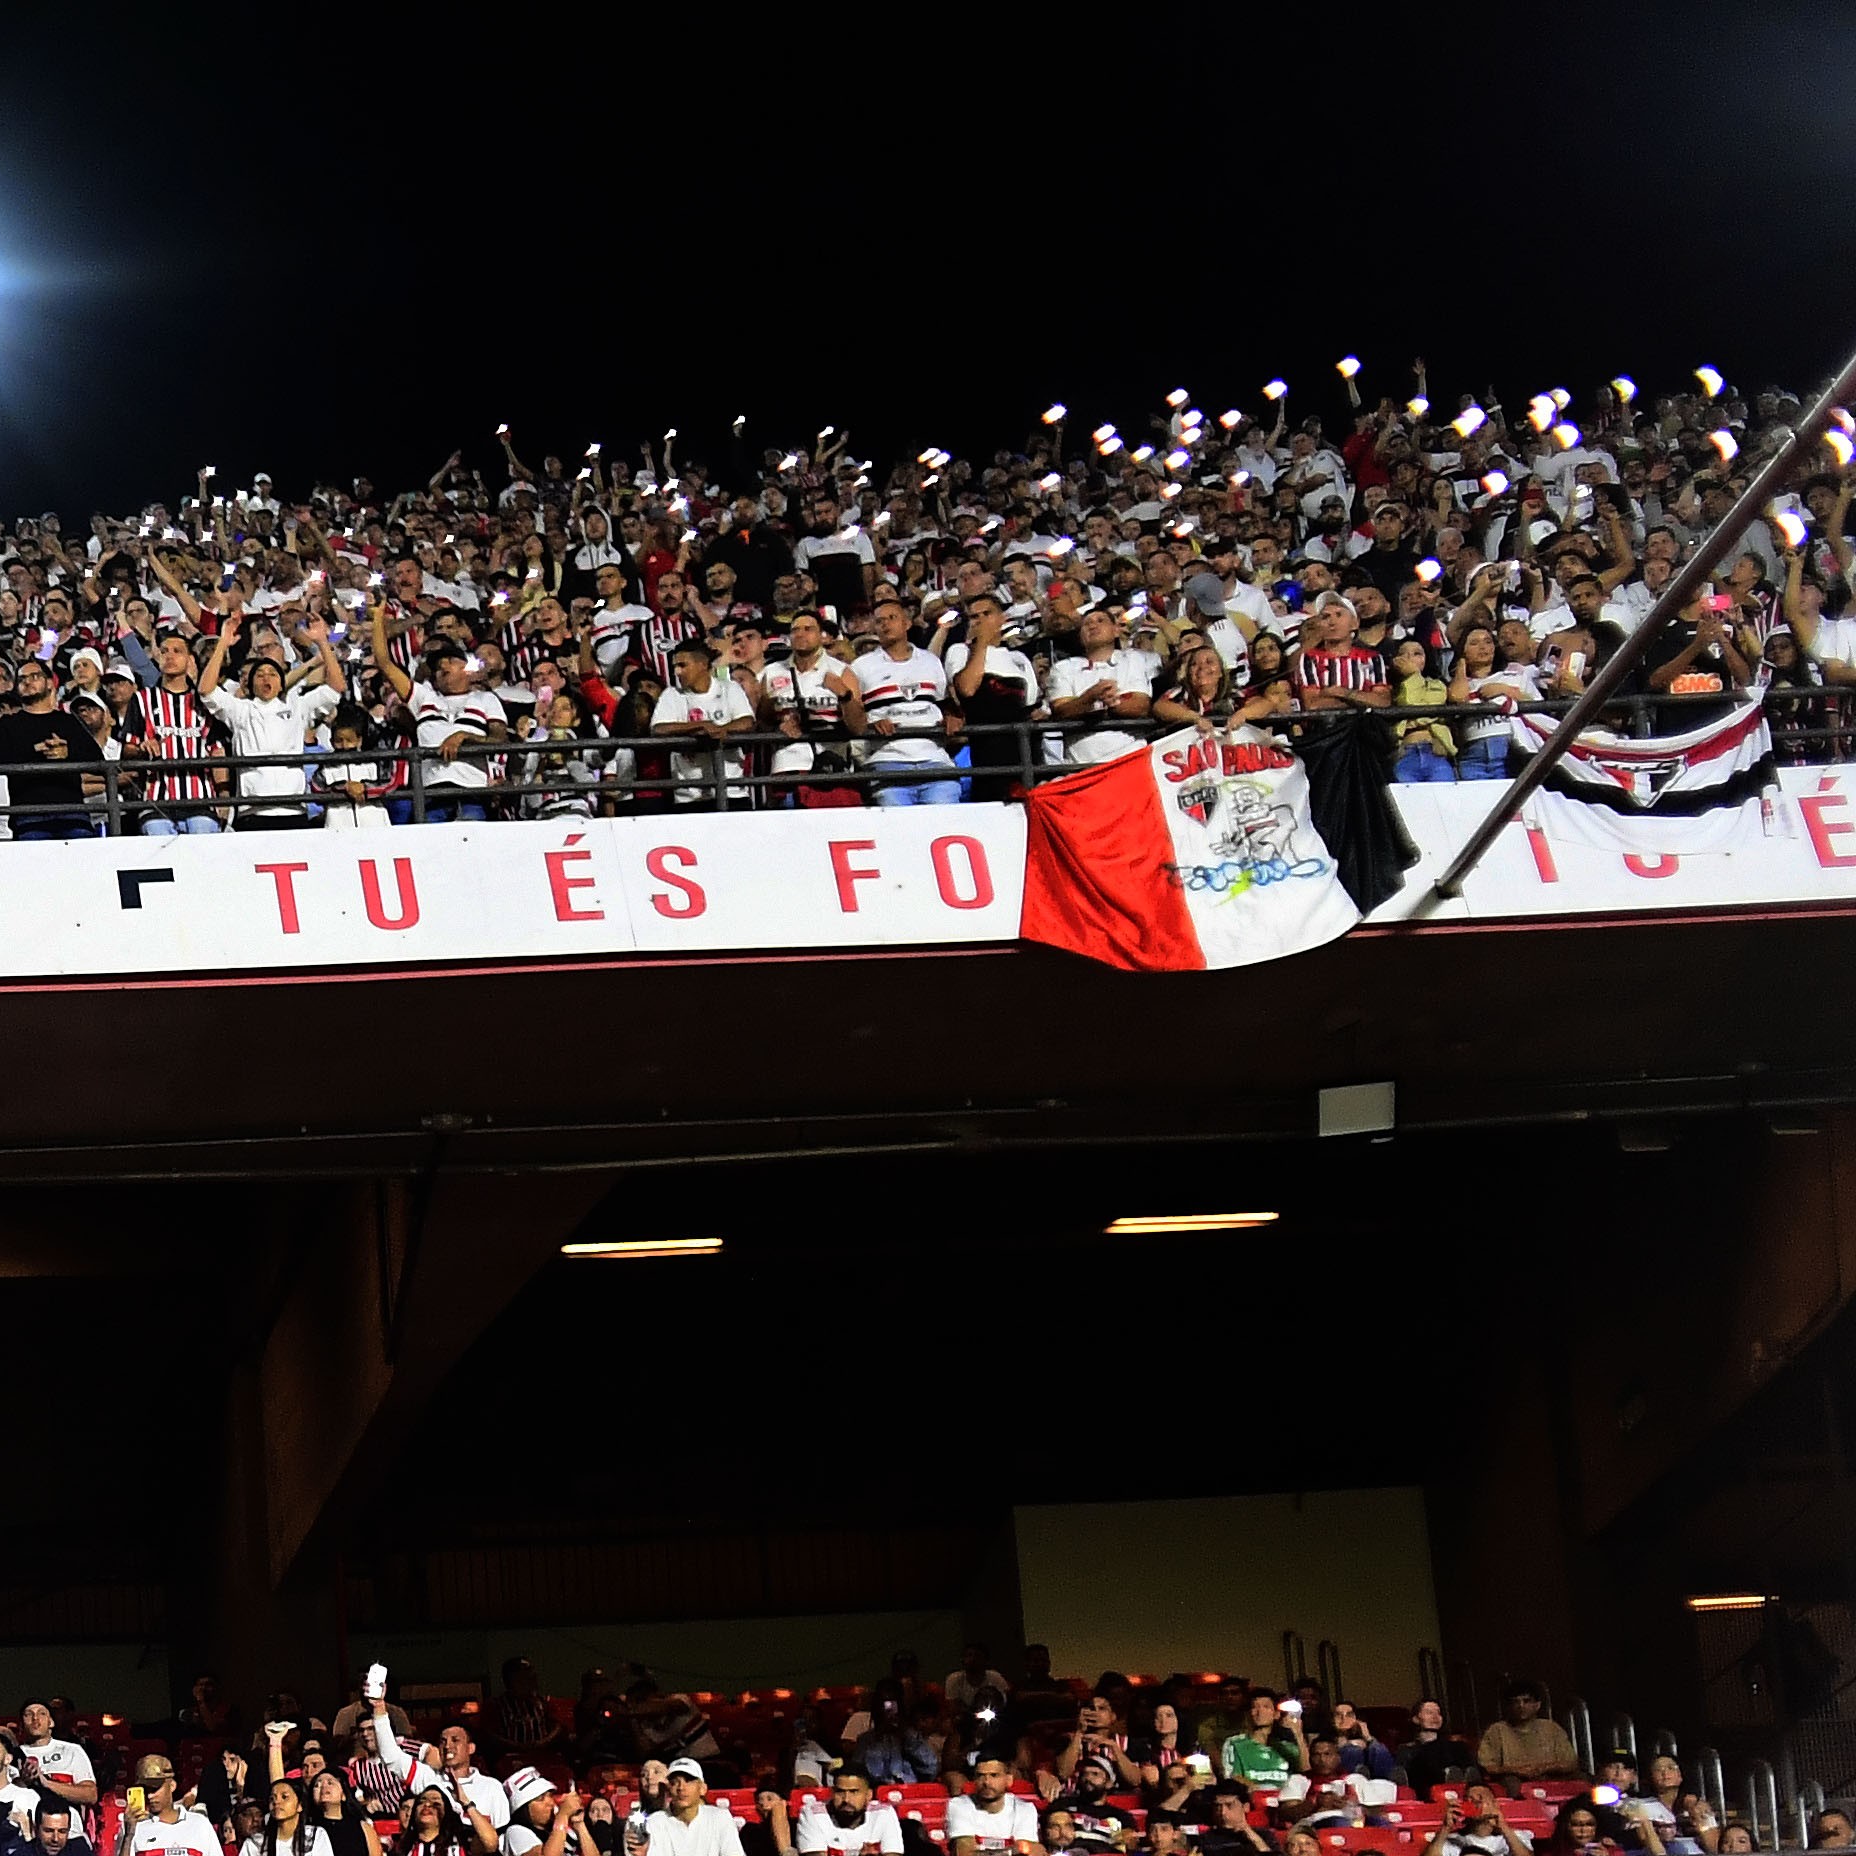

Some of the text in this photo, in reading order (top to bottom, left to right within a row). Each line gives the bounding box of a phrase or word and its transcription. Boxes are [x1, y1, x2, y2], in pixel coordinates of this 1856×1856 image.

[254, 832, 995, 934] TU ÉS FO
